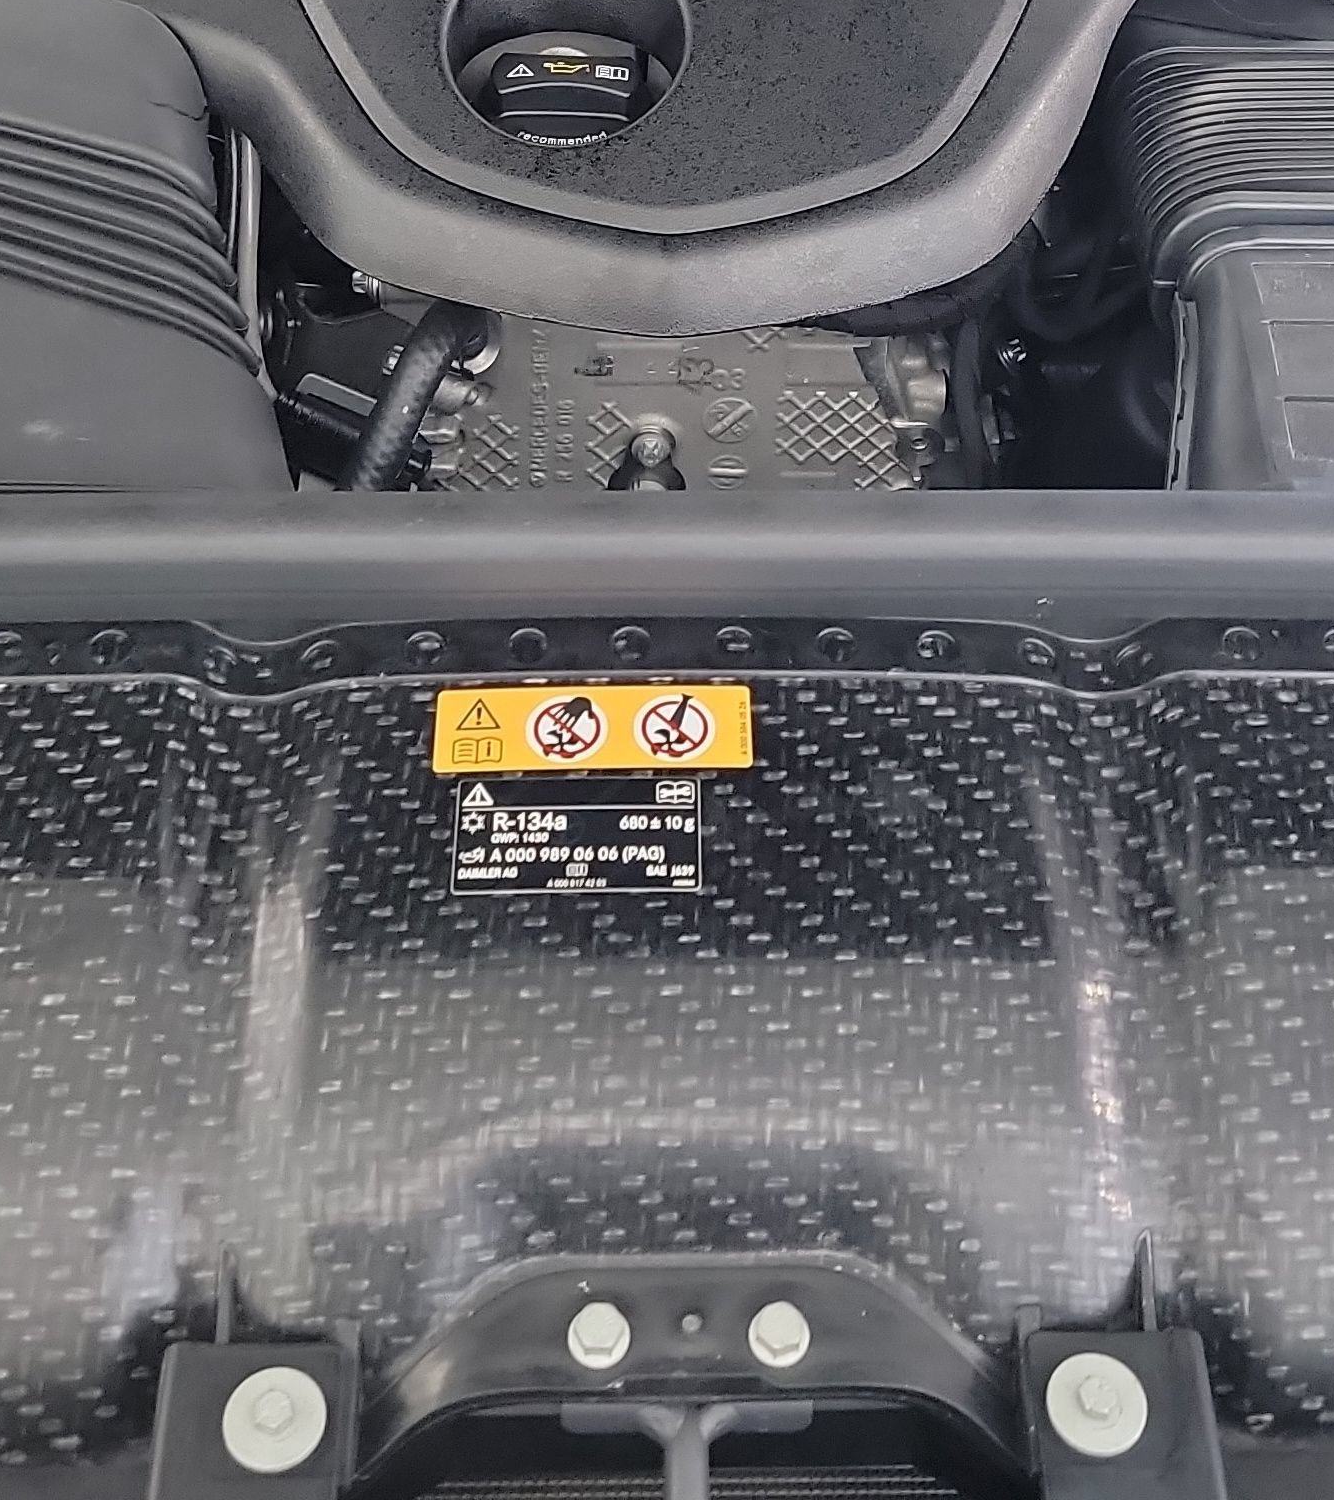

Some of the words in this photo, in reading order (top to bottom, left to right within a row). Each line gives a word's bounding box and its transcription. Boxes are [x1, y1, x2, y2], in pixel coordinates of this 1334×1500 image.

[517, 130, 608, 147] recommended
[530, 328, 548, 472] MERCEDES-BENZ
[492, 811, 568, 832] R-134a
[619, 814, 648, 831] 680
[664, 814, 683, 831] 10
[683, 817, 696, 833] g
[489, 847, 502, 863] A
[504, 846, 537, 863] 000
[539, 846, 570, 863] 989
[573, 845, 595, 862] 06
[597, 845, 619, 862] 06
[622, 844, 666, 864] (PAG)
[457, 866, 502, 880] DAIMLER
[502, 865, 519, 879] AG
[645, 864, 667, 877] SAE
